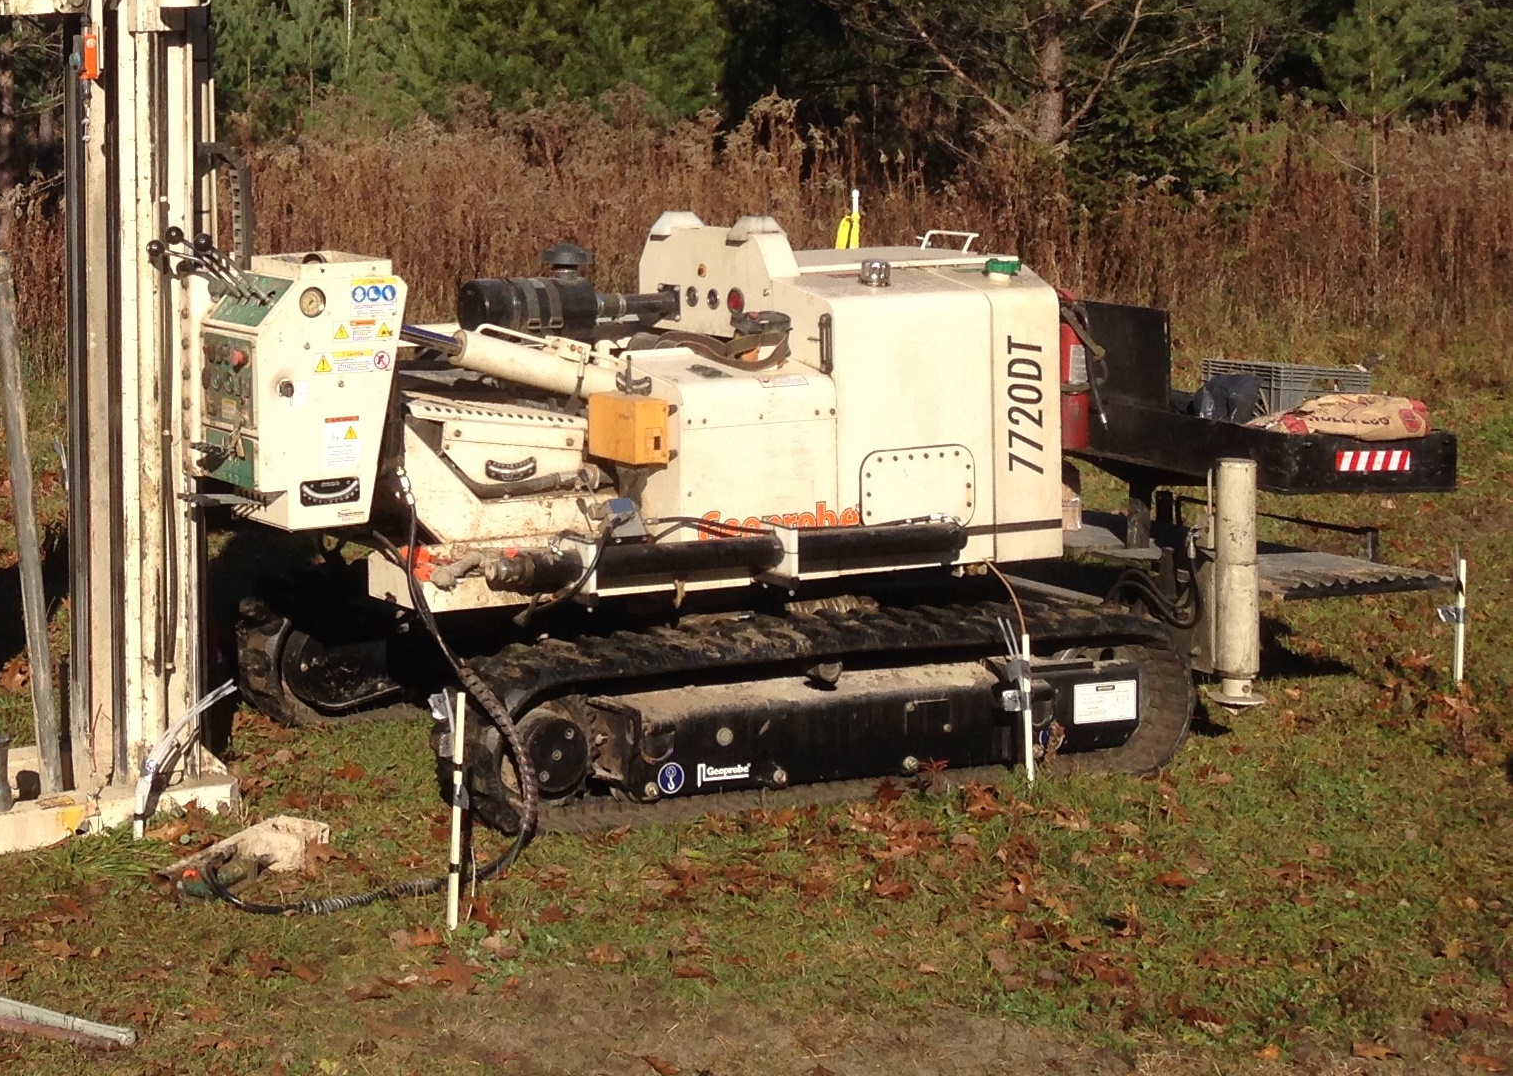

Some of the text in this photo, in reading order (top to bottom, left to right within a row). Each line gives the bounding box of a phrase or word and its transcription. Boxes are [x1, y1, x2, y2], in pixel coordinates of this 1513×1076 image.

[1007, 335, 1044, 475] 7720DT
[698, 501, 861, 541] Georobe
[706, 764, 750, 776] Geoprobe
